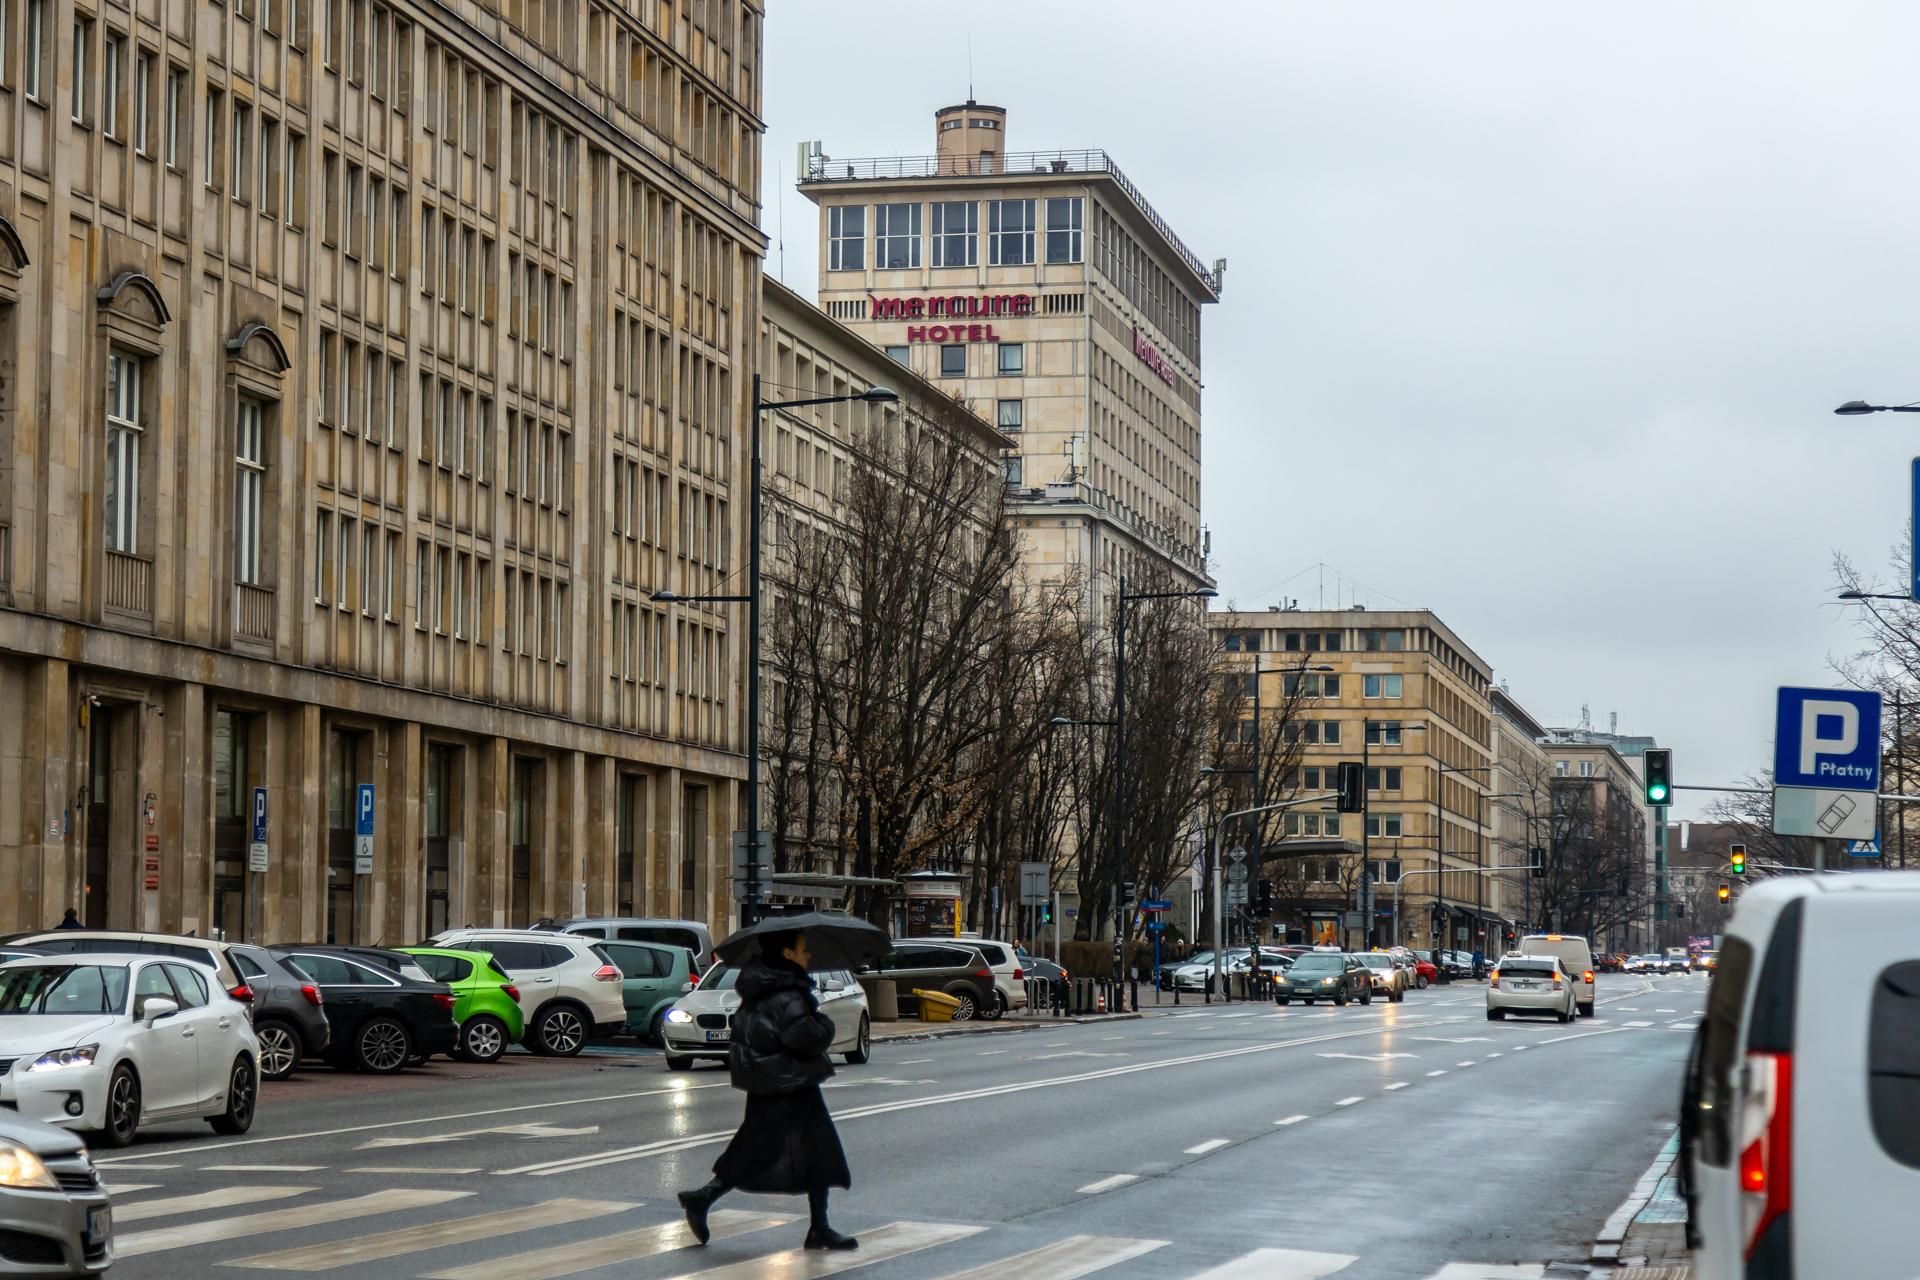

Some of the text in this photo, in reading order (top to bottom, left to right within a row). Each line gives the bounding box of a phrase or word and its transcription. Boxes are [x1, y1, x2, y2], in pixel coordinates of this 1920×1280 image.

[868, 294, 1039, 320] mercure
[908, 324, 1000, 343] HOTEL
[1800, 699, 1860, 775] P
[1819, 762, 1873, 781] Płatny
[256, 792, 265, 826] P
[361, 789, 372, 821] P
